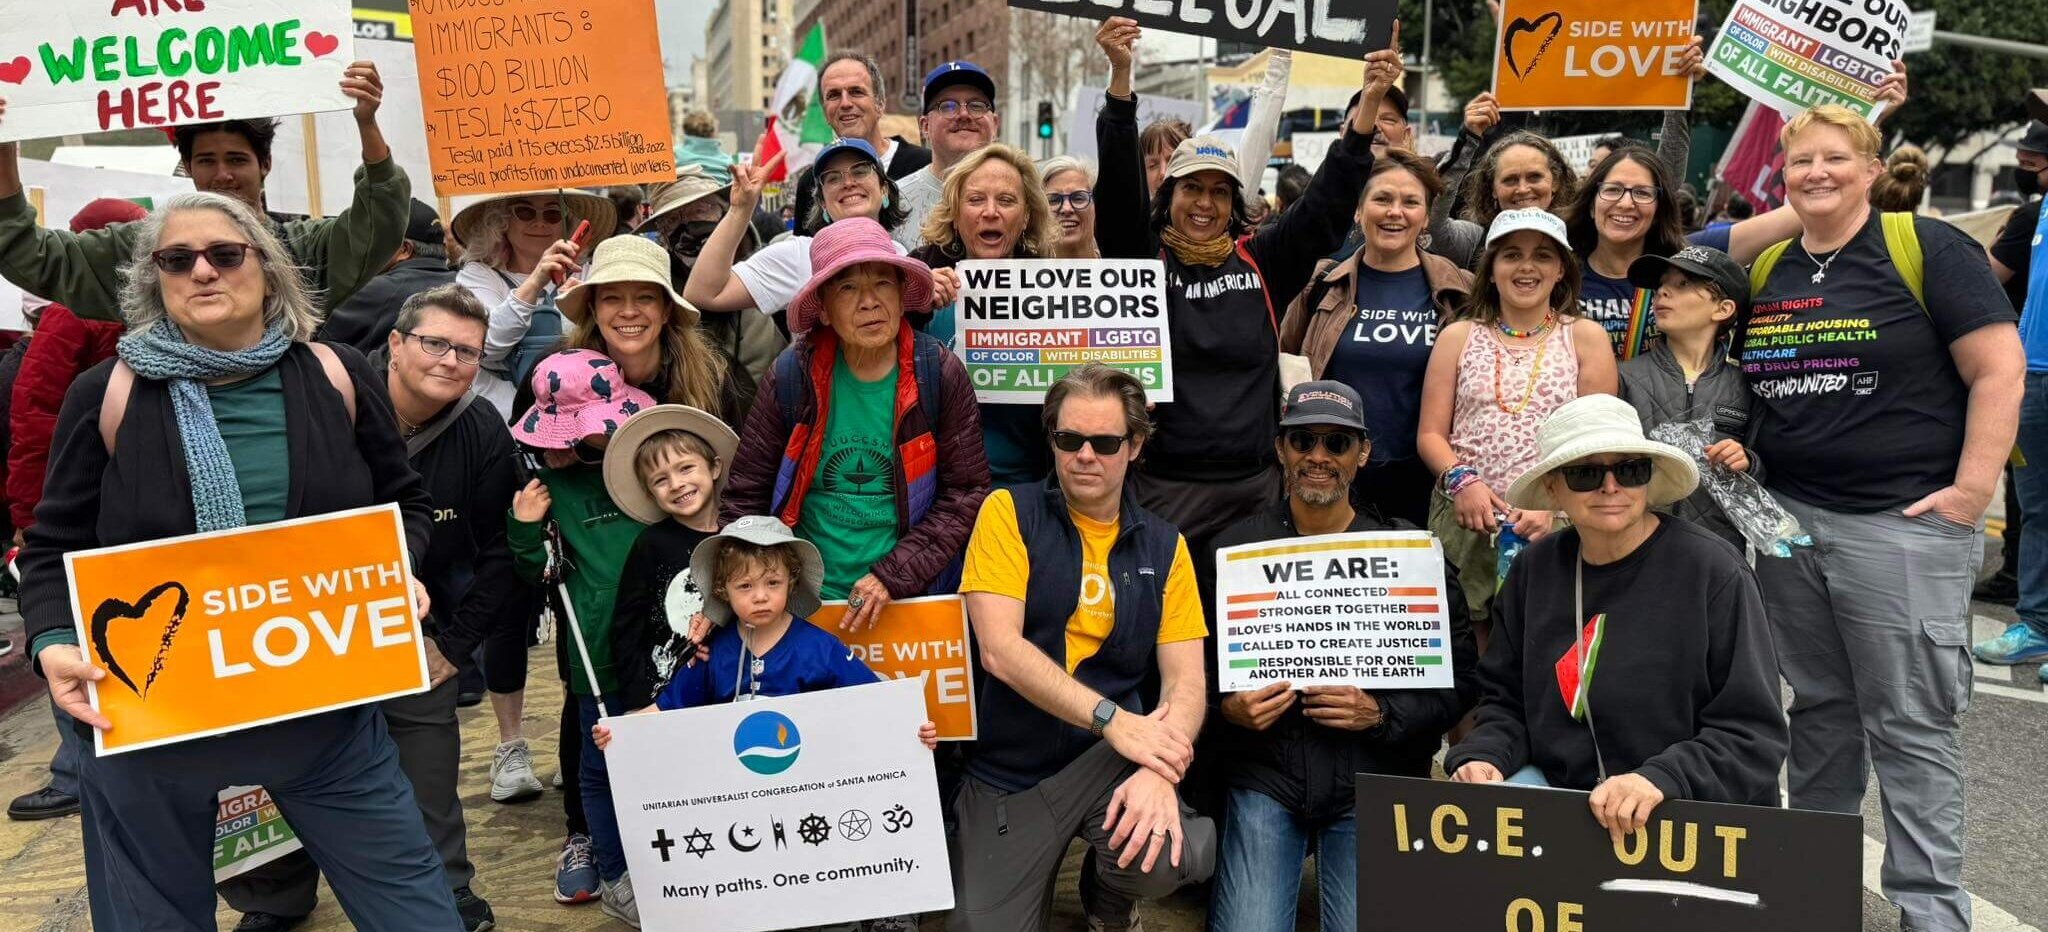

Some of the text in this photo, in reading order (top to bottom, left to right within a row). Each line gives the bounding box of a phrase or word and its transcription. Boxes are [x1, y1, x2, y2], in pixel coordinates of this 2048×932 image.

[1569, 18, 1693, 38] SIDE WITH
[1864, 0, 1908, 39] OUR
[38, 19, 301, 85] WELCOME
[1730, 26, 1741, 37] OF
[1739, 31, 1765, 52] COLOR
[1770, 46, 1797, 67] WITH
[1737, 7, 1887, 86] IMMIGRANT LGBTQ
[1563, 45, 1687, 77] LOVE
[1719, 42, 1737, 63] OF
[1733, 52, 1768, 84] ALL
[436, 54, 590, 100] $100 BILLION
[98, 81, 225, 131] HERE
[442, 146, 484, 165] Tesla
[488, 142, 514, 168] paid
[518, 138, 542, 156] its
[612, 131, 644, 150] billion
[447, 168, 486, 188] Tesla
[489, 163, 528, 189] profits
[528, 161, 558, 181] from
[630, 158, 672, 175] workers
[965, 269, 1012, 289] WE
[1020, 269, 1091, 289] LOVE
[1100, 268, 1157, 288] OUR
[1185, 281, 1201, 298] AN
[1203, 272, 1262, 298] AMERICAN
[964, 294, 1159, 320] NEIGHBORS
[1360, 309, 1396, 321] SIDE
[1781, 297, 1824, 310] RIGHTS
[1353, 322, 1437, 347] LOVE
[1805, 318, 1870, 331] HOUSING
[971, 330, 1157, 346] IMMIGRANT LGBTQ
[1771, 333, 1815, 346] PUBLIC
[1817, 329, 1877, 342] HEALTH
[972, 349, 1157, 361] OF COLOR WITH DISABILITIES
[1764, 361, 1800, 372] DRUG
[1803, 357, 1860, 370] PRICING
[973, 369, 1007, 386] OF
[1856, 376, 1874, 385] AHF
[1262, 557, 1399, 584] WE ARE:
[202, 560, 404, 616] SIDE WITH
[1276, 587, 1389, 600] ALL CONNECTED
[1259, 603, 1408, 618] STRONGER TOGETHER
[206, 596, 413, 680] LOVE
[1237, 620, 1432, 636] LOVE'S HANDS IN THE WORLD
[892, 639, 964, 661] WITH
[1242, 638, 1429, 652] CALLED TO CREATE JUSTICE
[1249, 667, 1425, 679] ANOTHER AND THE EARTH
[1259, 655, 1415, 668] RESPONSIBLE FOR ONE
[642, 799, 689, 811] UNITARIAN
[690, 790, 749, 806] UNIVERSALIST
[751, 782, 826, 799] CONGREGATION
[836, 776, 865, 788] SANTA
[867, 769, 907, 784] MONICA
[233, 825, 284, 858] ALL
[1392, 803, 1748, 878] I.C.E. OUT
[662, 856, 921, 899] Many paths. One community.
